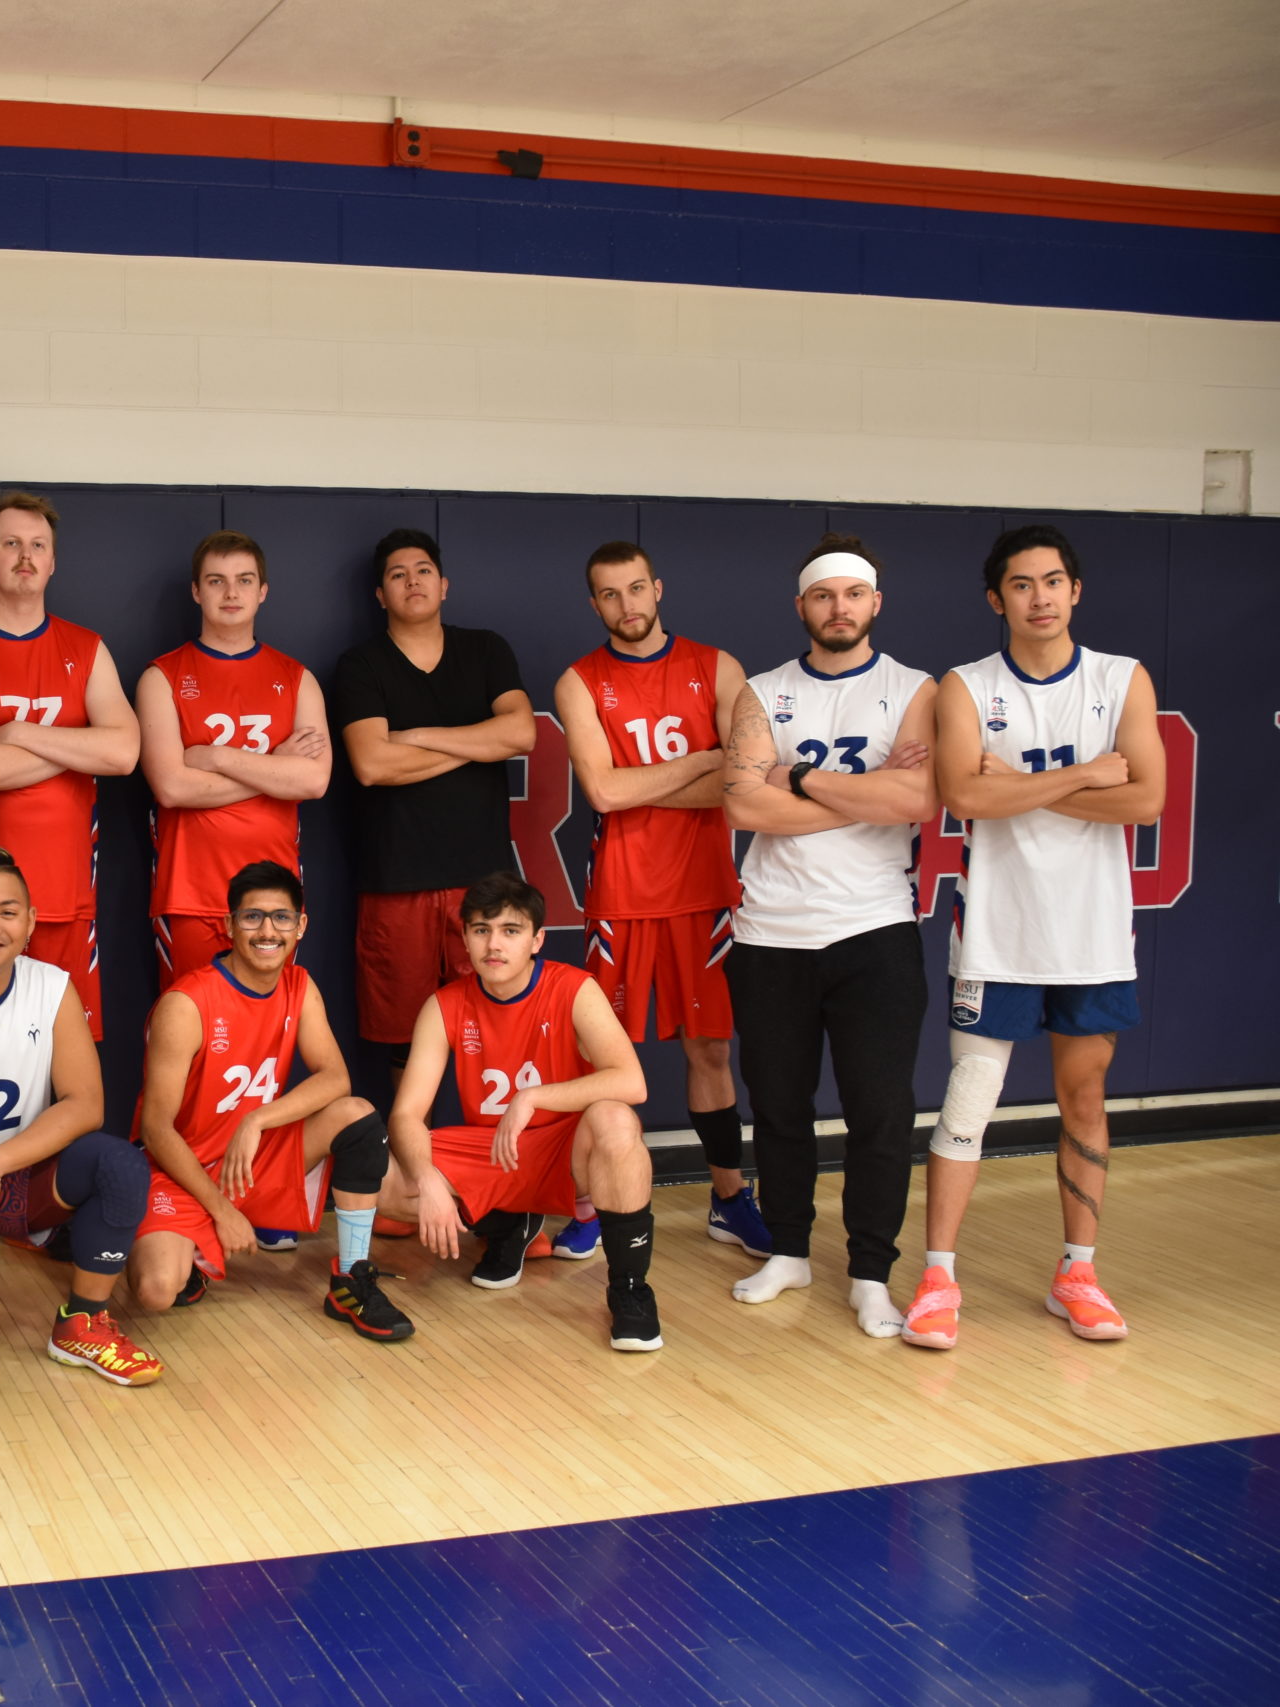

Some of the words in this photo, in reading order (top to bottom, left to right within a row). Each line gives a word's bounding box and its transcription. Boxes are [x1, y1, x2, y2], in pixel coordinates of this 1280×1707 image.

[204, 713, 272, 755] 23
[624, 716, 689, 764] 16
[796, 736, 868, 774] 23
[215, 1057, 280, 1114] 24
